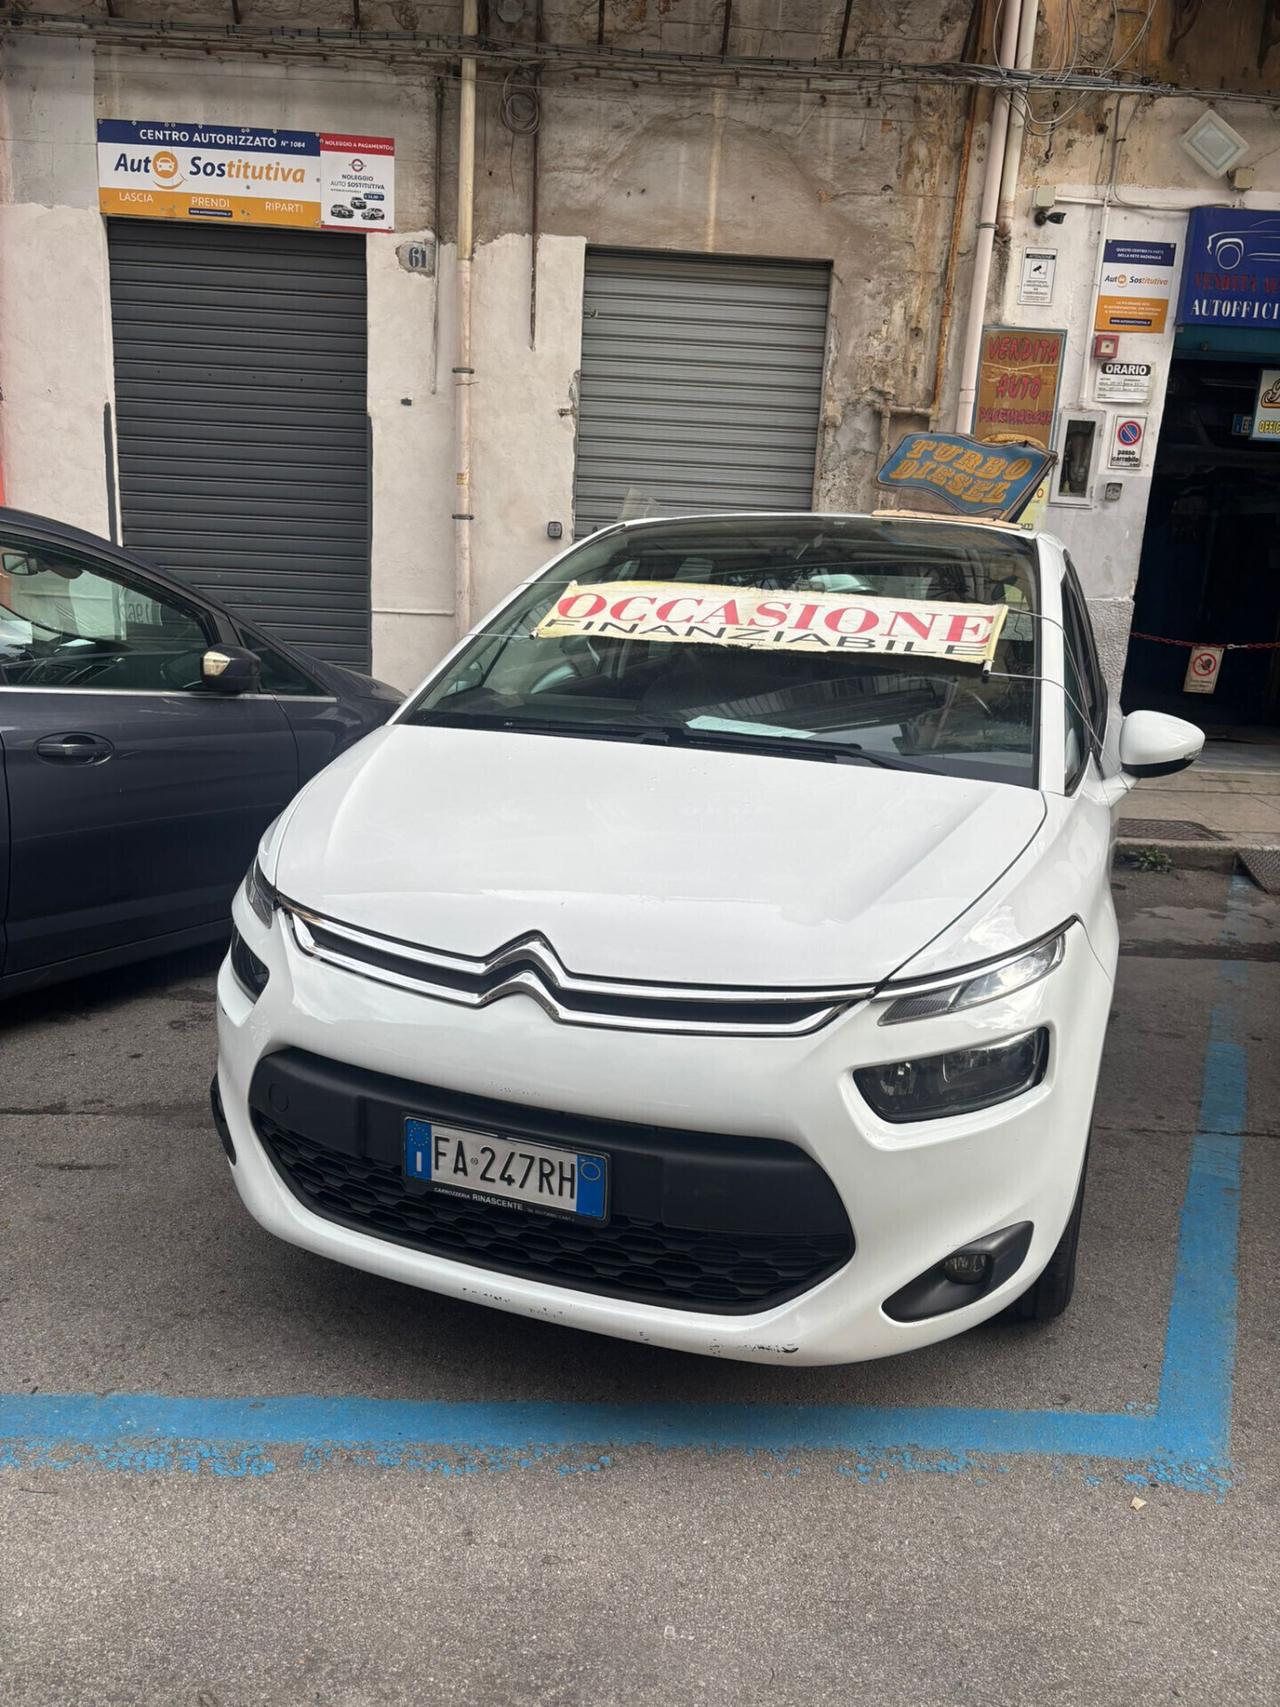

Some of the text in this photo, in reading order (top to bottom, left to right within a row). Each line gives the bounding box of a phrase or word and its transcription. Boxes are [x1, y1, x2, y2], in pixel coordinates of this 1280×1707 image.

[139, 129, 189, 142] CENTRO
[193, 133, 277, 148] AUTORIZZATO
[325, 140, 353, 148] NOLEGGIO
[358, 143, 391, 151] PAGAMENTO
[189, 156, 306, 183] Sostitutiva
[341, 174, 374, 182] NOLEGGIO
[347, 182, 385, 190] SOSTITUTIVA
[119, 192, 304, 213] LASCIA PRENDI RIPARTI
[408, 246, 427, 268] 61
[1129, 275, 1169, 286] Sostitutiva
[988, 335, 1060, 364] VENDITA
[1105, 364, 1147, 376] ORARIO
[996, 374, 1041, 400] AUTO
[906, 438, 1033, 481] TURBO
[889, 459, 1011, 504] DIESEL
[557, 593, 994, 645] OCCASIONE
[545, 618, 987, 657] FINANZIABILE
[472, 1193, 523, 1211] RINASCENTE
